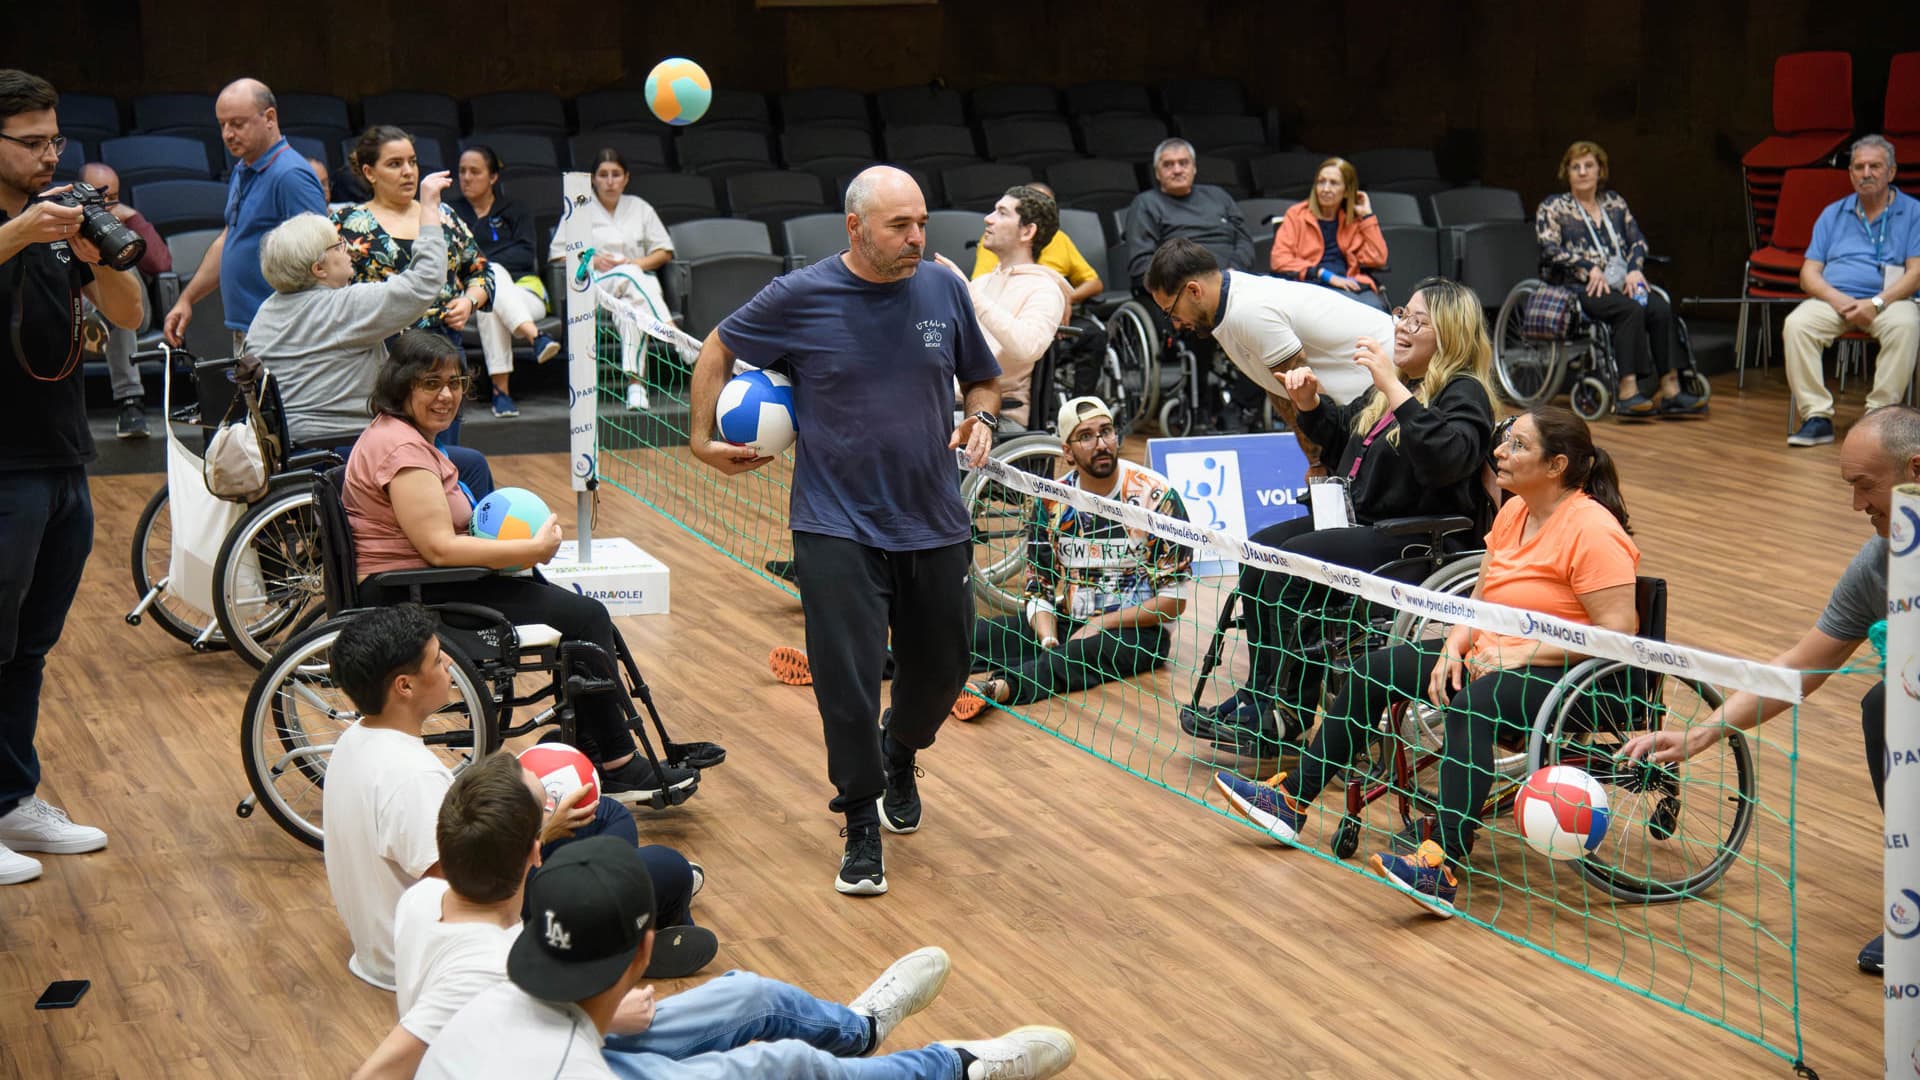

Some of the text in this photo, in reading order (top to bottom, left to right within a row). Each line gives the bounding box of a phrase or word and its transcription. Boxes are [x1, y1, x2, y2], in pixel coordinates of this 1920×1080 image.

[585, 590, 643, 600] PARAVOLEI
[1533, 620, 1587, 647] PARAVOLEI
[1893, 747, 1920, 766] PA
[545, 910, 571, 949] LA
